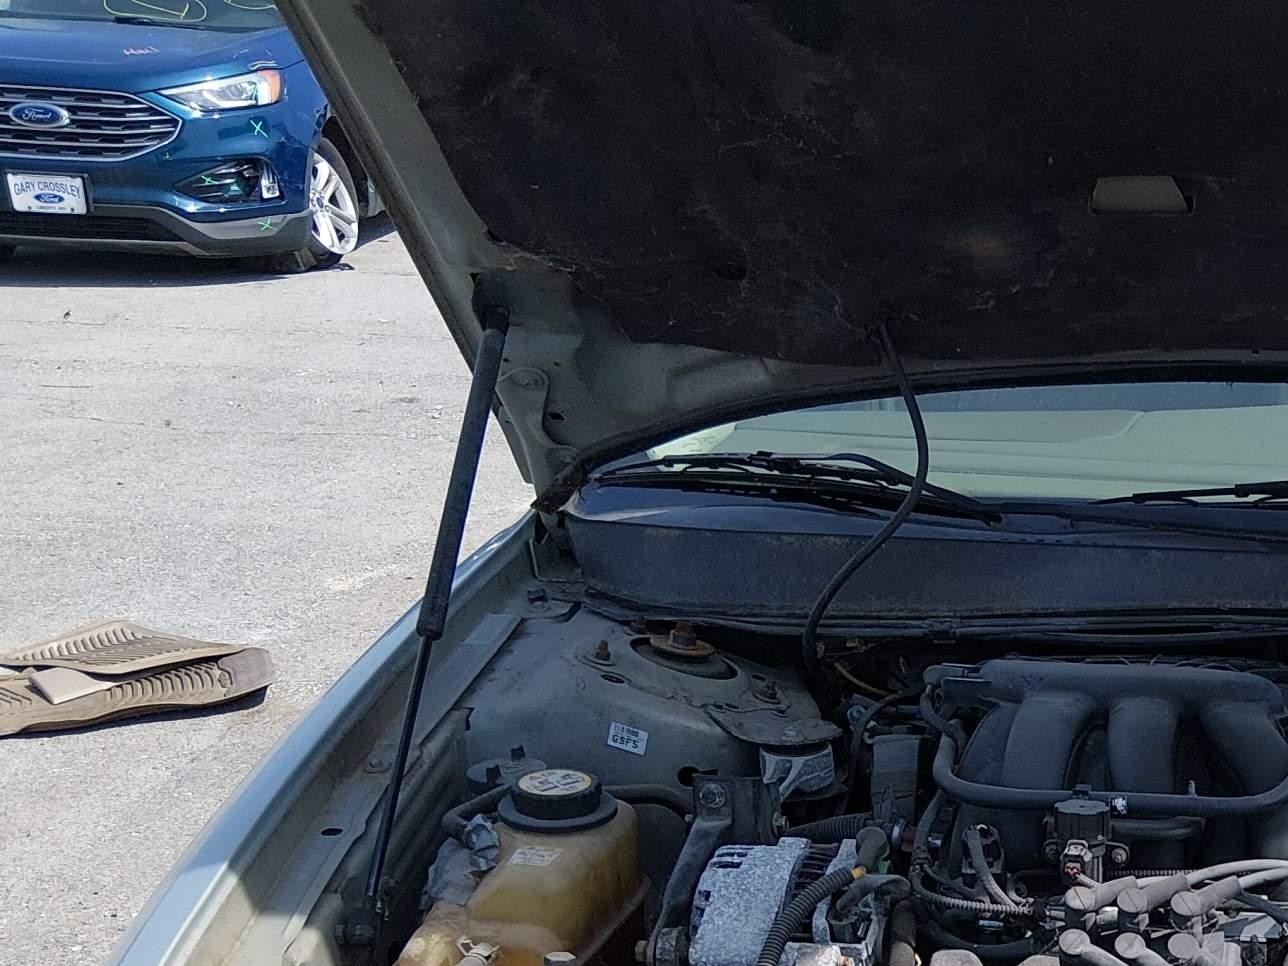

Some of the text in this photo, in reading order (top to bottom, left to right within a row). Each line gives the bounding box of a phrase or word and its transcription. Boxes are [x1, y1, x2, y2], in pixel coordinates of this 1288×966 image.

[22, 108, 52, 120] Ford
[13, 181, 80, 199] GARY CROSSLEY
